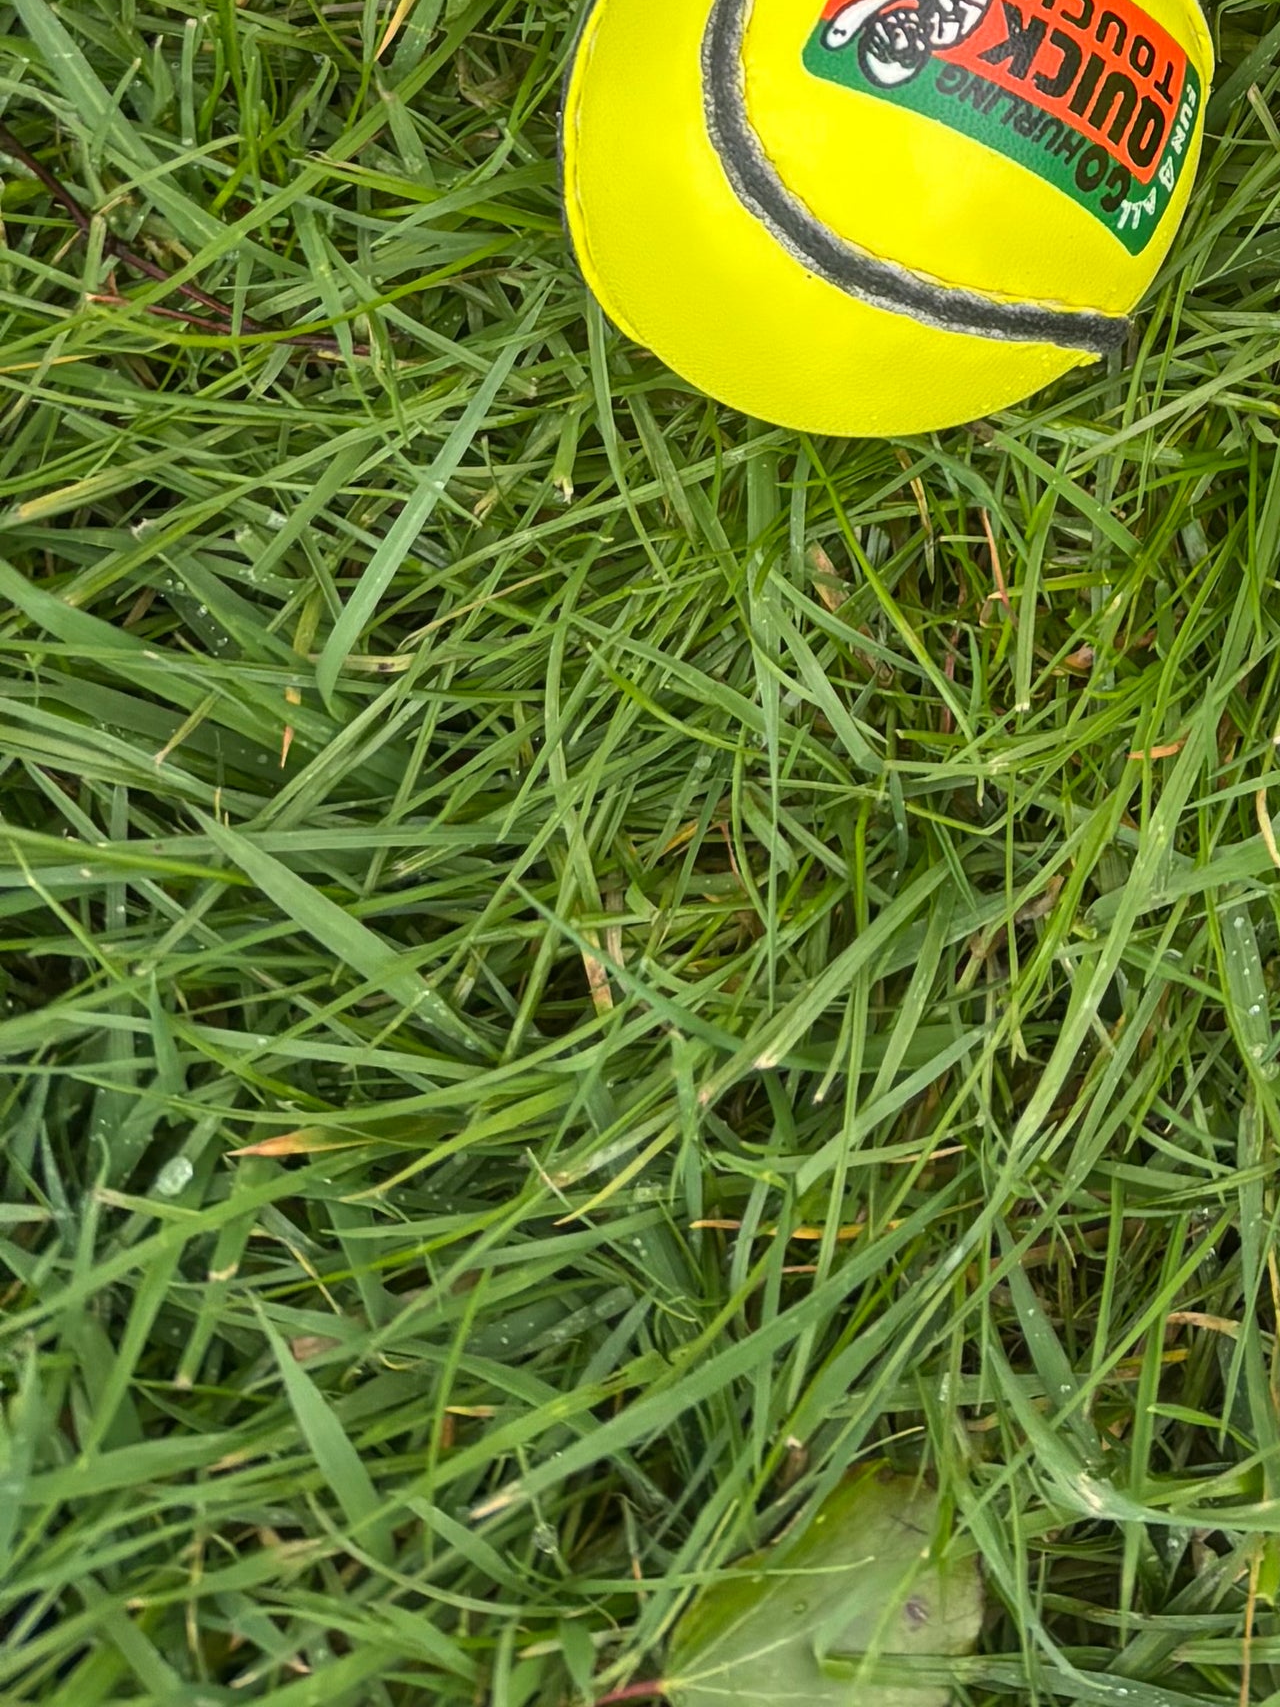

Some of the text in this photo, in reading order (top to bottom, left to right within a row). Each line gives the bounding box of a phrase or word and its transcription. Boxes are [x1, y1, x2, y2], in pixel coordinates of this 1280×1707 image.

[1116, 83, 1197, 230] FUN 4 ALL
